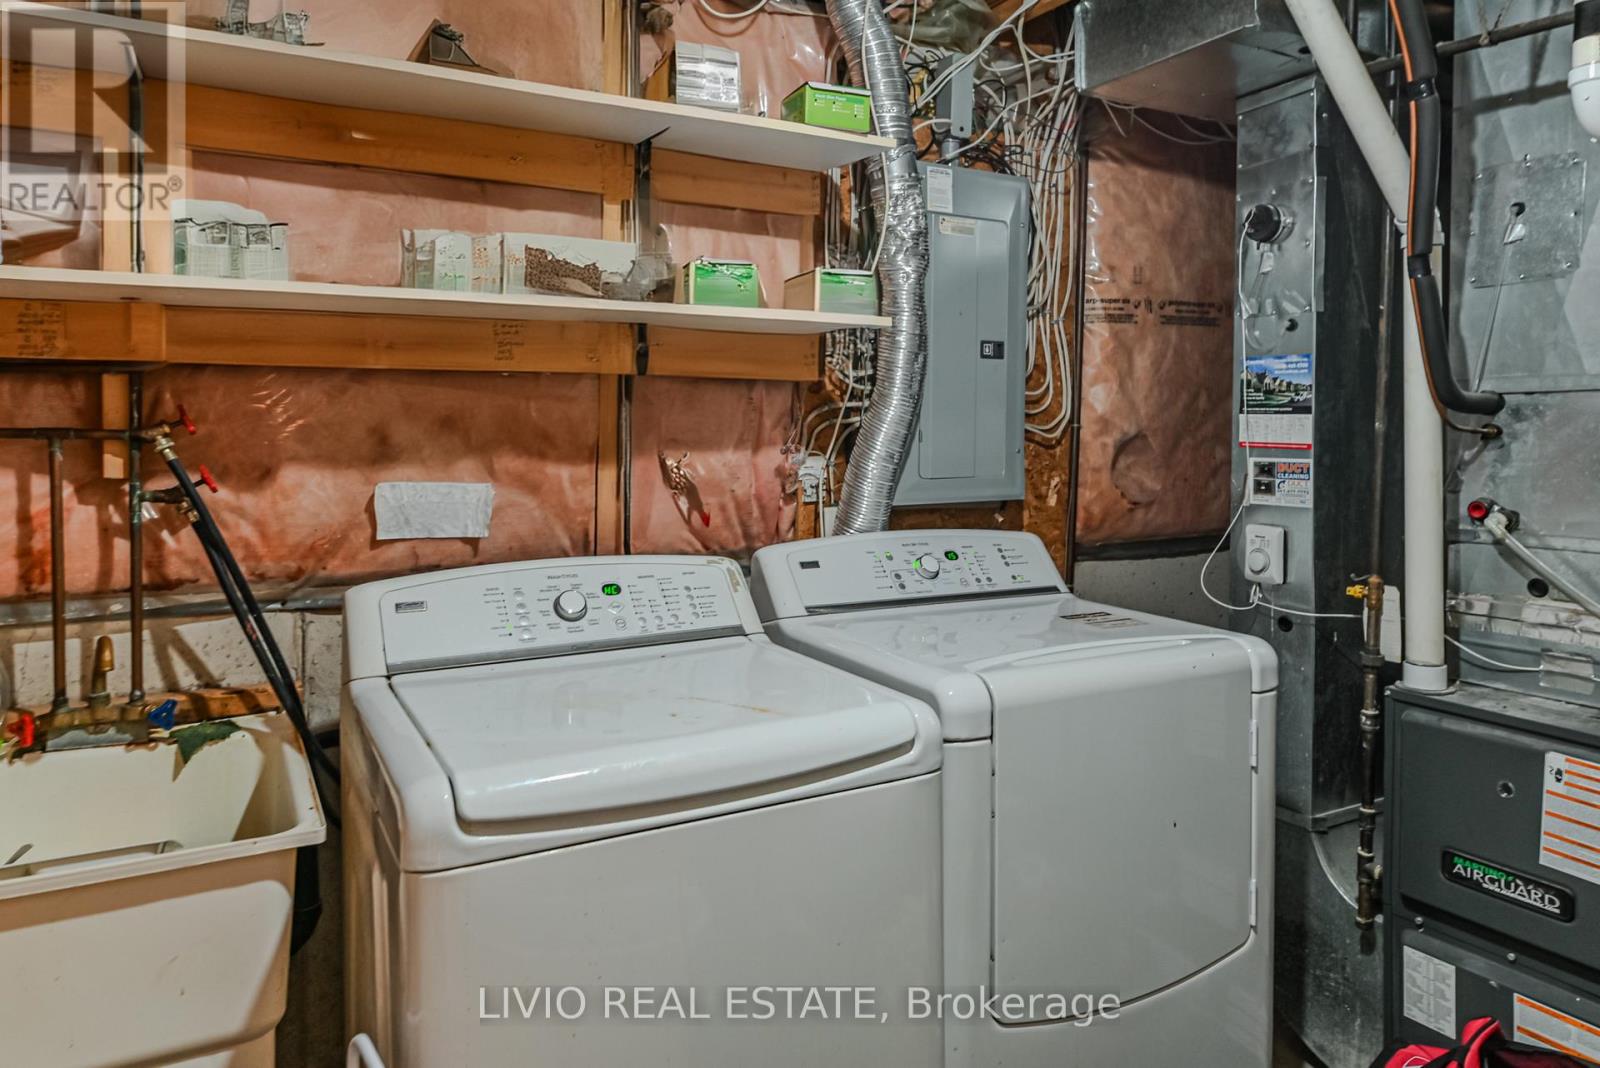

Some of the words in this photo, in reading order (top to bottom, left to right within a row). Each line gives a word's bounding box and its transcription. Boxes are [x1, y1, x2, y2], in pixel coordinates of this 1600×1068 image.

[1277, 462, 1310, 474] DUCT
[1277, 472, 1310, 480] CLEANING
[1452, 863, 1561, 909] AIRGUARD
